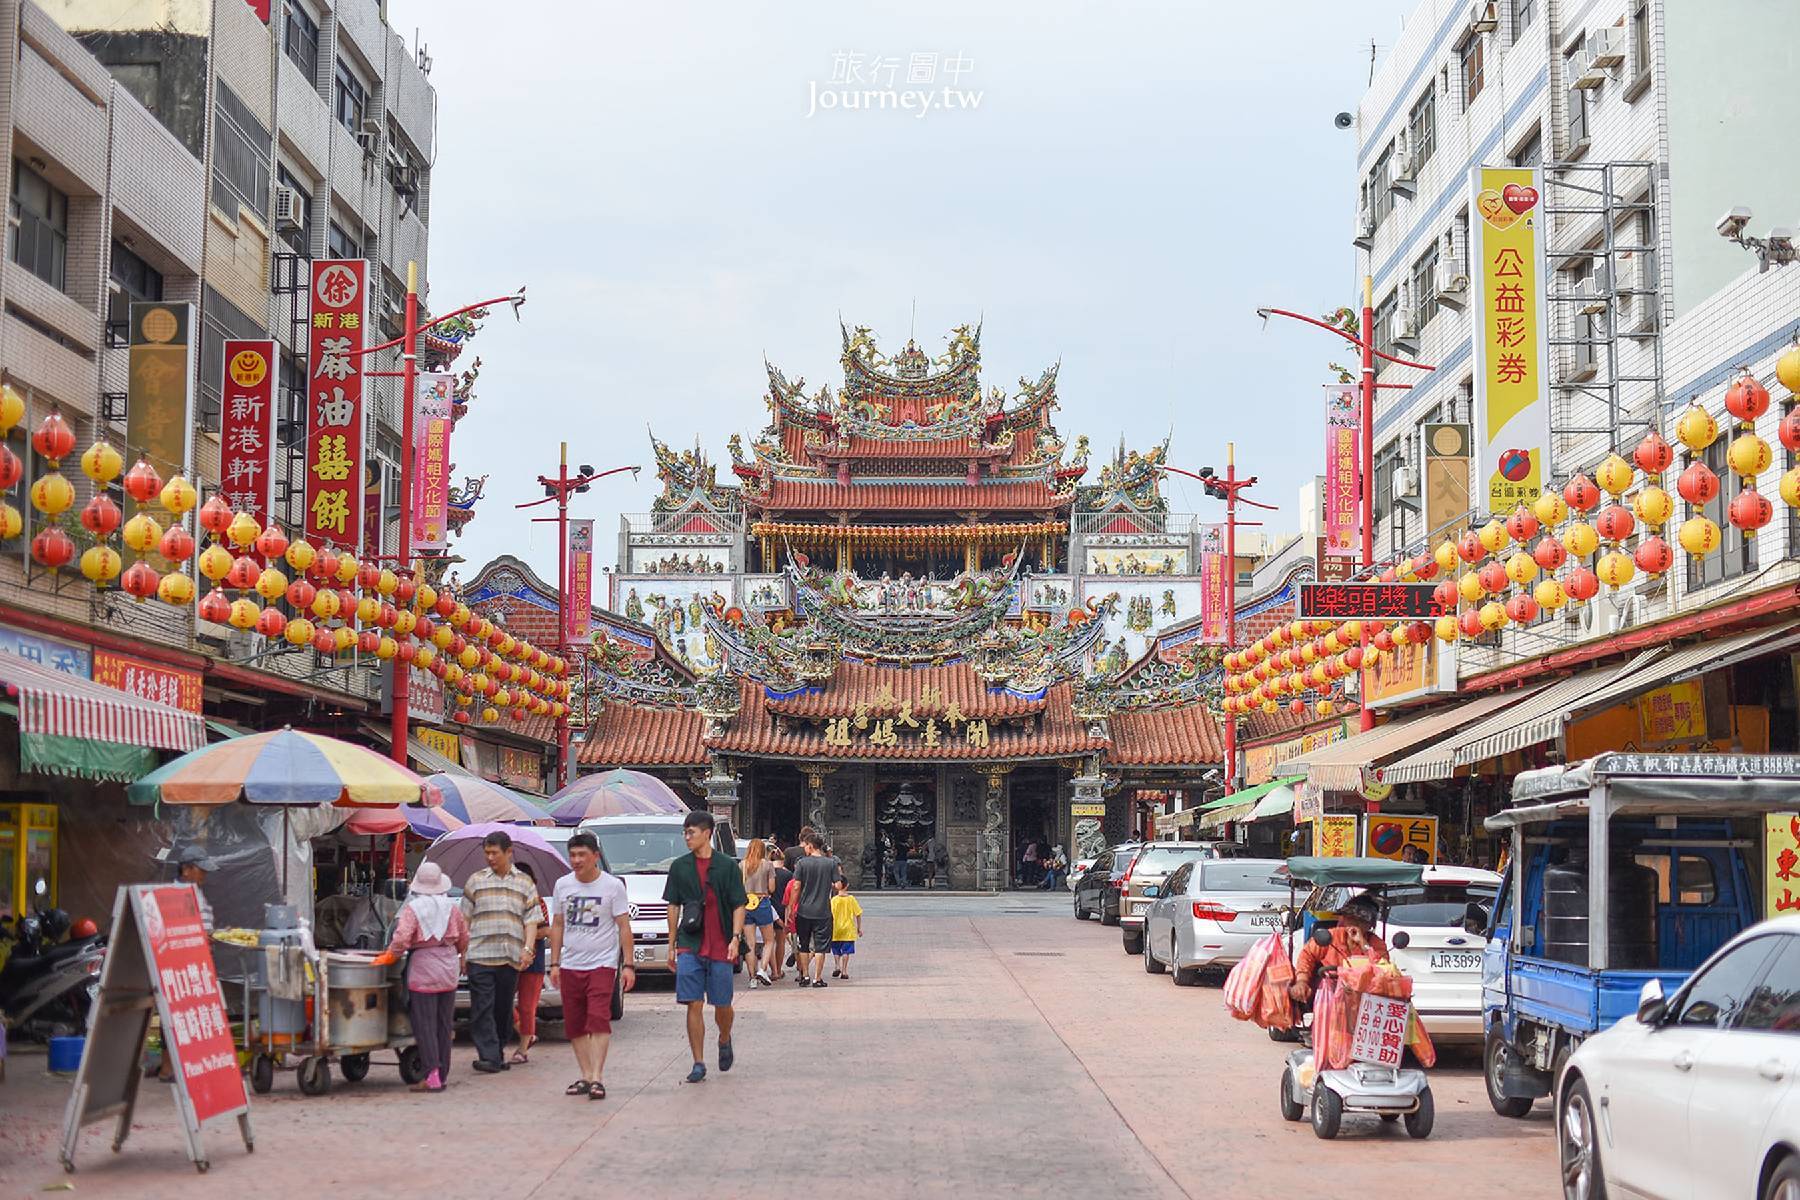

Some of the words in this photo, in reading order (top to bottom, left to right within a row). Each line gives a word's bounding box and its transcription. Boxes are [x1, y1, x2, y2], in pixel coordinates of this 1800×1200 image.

[322, 270, 356, 304] 徐
[313, 312, 360, 330] 新港
[1494, 248, 1527, 384] 公益彩券
[227, 394, 265, 551] 新港軒囍
[425, 420, 445, 518] 國際媽祖文化節
[1338, 429, 1353, 525] 國際媽祖文化節
[849, 700, 966, 729] 奉天宮
[161, 962, 216, 1003] 門口禁止
[1430, 955, 1482, 969] AJR-3899
[172, 1003, 225, 1046] 臨時停車
